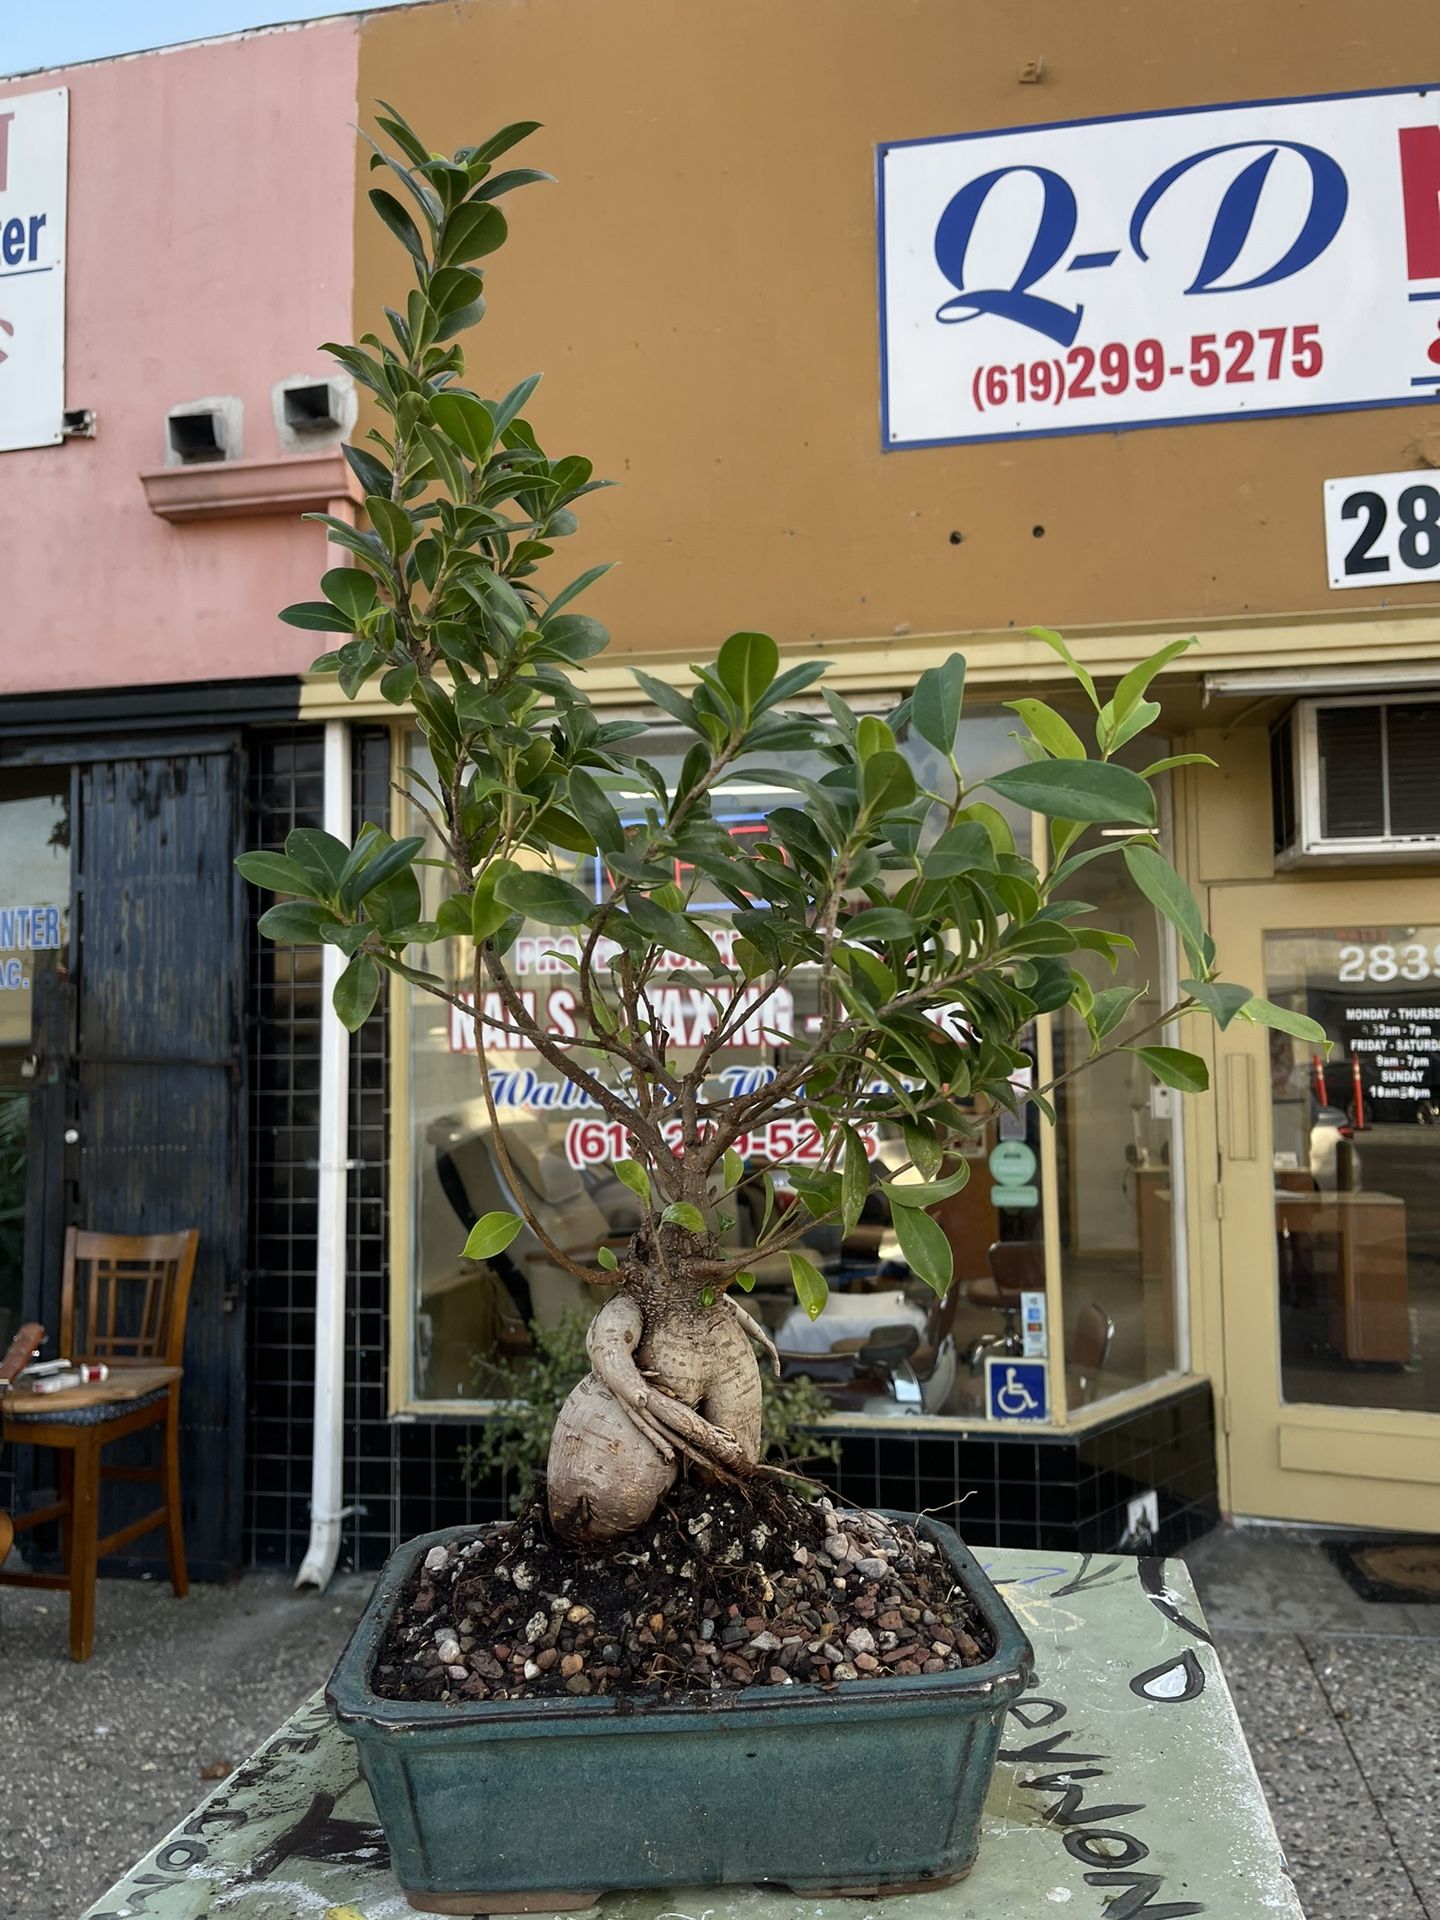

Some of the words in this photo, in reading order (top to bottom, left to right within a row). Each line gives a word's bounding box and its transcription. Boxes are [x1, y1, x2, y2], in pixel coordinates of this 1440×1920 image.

[934, 139, 1349, 348] Q-D
[972, 324, 1323, 412] (619)299-5275
[1345, 1008, 1390, 1021] MONDAY
[1408, 1023, 1432, 1038] 7pm
[1350, 1039, 1388, 1051] FRIDAY
[1406, 1054, 1430, 1069] 7pm
[1381, 1070, 1424, 1082] SUNDAY
